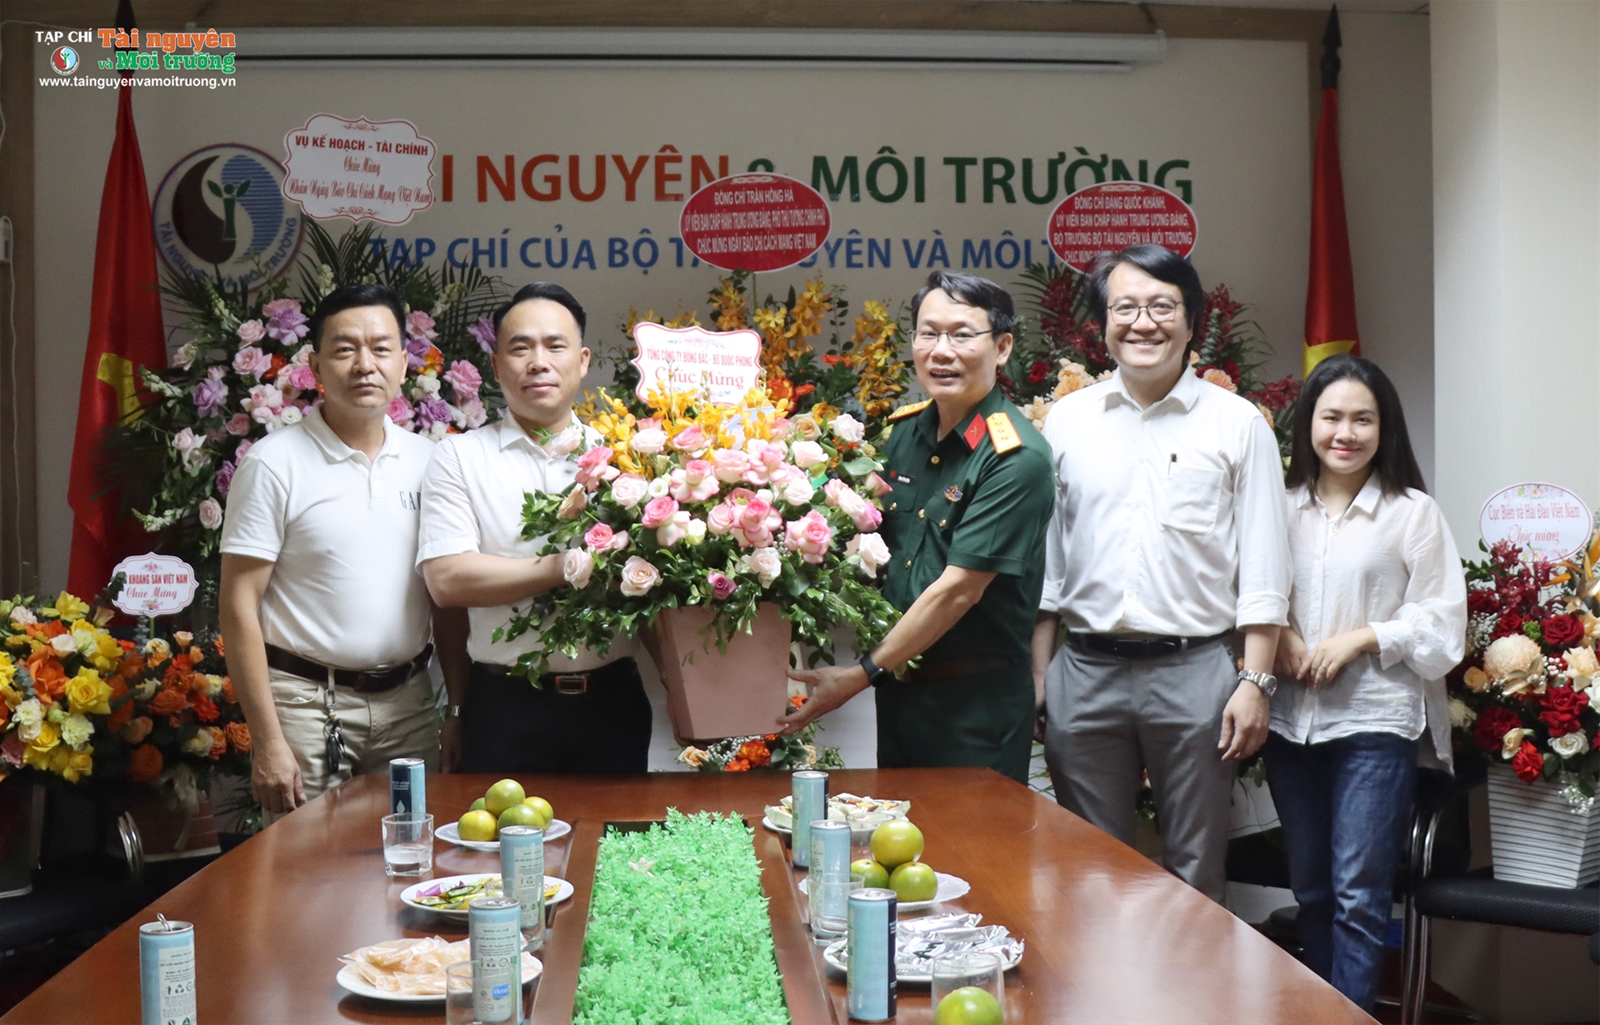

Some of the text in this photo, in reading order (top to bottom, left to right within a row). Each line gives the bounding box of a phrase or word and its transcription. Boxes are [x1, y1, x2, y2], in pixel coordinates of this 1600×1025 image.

[295, 135, 308, 147] VỤ
[312, 133, 326, 148] KẾ
[329, 138, 365, 152] HOẠCH
[376, 140, 392, 153] TÀI
[395, 142, 428, 156] CHÍNH
[344, 155, 360, 173] Chúc
[810, 146, 926, 203] MÔI
[714, 185, 794, 205] ĐỒNG CHÍ TRẦN HỒNG HÀ
[1094, 193, 1105, 208] CHÍ
[1124, 193, 1142, 209] QUỐC
[1066, 210, 1079, 227] VIÊN
[1080, 214, 1092, 227] BAN
[1093, 211, 1110, 227] CHẤP
[1111, 211, 1128, 227] HÀNH
[1129, 213, 1150, 227] TRUNG
[1054, 231, 1063, 248] BỘ
[1093, 231, 1102, 248] BỘ
[1103, 229, 1114, 244] TÀI
[1115, 229, 1140, 245] NGUYÊN
[447, 228, 511, 268] CHÍ
[519, 224, 597, 270] CỦA
[608, 228, 660, 275] BỘ
[902, 229, 951, 268] VÀ
[962, 230, 1031, 269] MÔI
[655, 366, 744, 390] Chúc Mừng
[1565, 501, 1580, 518] Nam
[176, 574, 188, 584] NAM
[126, 587, 148, 598] Chúc
